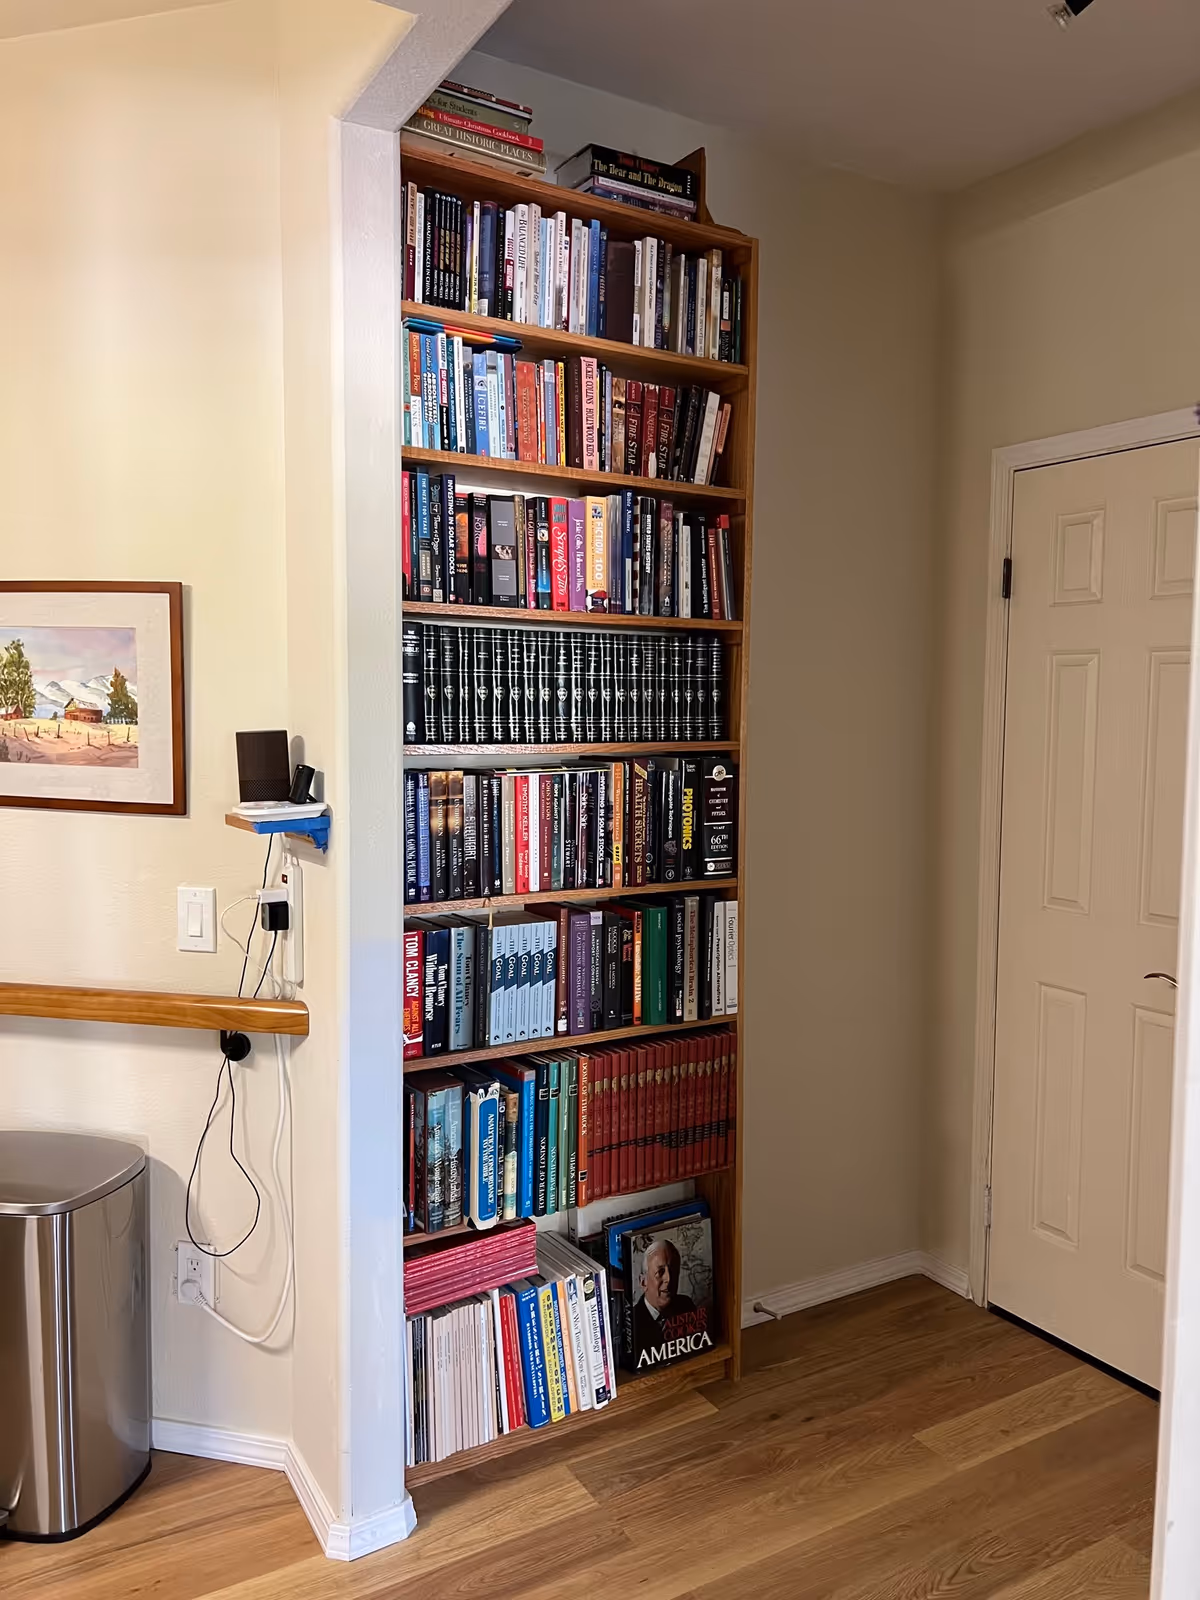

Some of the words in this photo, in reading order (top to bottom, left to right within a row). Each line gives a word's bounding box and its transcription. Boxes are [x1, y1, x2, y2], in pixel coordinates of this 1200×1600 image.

[424, 120, 452, 136] GREAT
[456, 130, 498, 150] HISTORIC
[500, 144, 533, 161] PLACES
[464, 120, 491, 134] Christmas
[492, 128, 520, 142] Cookbook
[593, 159, 608, 172] The
[609, 164, 626, 178] Bear
[628, 170, 642, 182] and
[644, 172, 656, 186] The
[658, 177, 682, 193] Dragon
[518, 219, 527, 256] BALANCED
[518, 256, 526, 271] LIFE
[584, 360, 594, 379] JACKIE
[586, 381, 594, 405] COLLINS
[478, 393, 486, 431] ICEFIRE
[586, 408, 594, 442] HOLLYWOOD
[628, 418, 637, 438] FIRE
[645, 410, 656, 448] INKHEART
[660, 423, 670, 443] FIRE
[628, 440, 637, 464] STAR
[659, 445, 668, 469] STAR
[558, 574, 567, 595] Two
[635, 778, 643, 817] HEALTH
[682, 788, 693, 850] PHOTONICS
[465, 816, 476, 860] STEELHEART
[635, 819, 643, 863] SECRETS
[405, 936, 418, 957] TOM
[406, 960, 419, 997] CLANCY
[425, 953, 437, 984] Without
[438, 964, 447, 980] Tom
[456, 977, 464, 986] of
[425, 987, 436, 1021] Remorse
[435, 981, 446, 1006] Clancy
[582, 1087, 588, 1097] OF
[433, 1159, 442, 1206] Wonderlands
[449, 1156, 459, 1202] Historylands
[539, 1171, 545, 1180] OF
[590, 1304, 602, 1353] Microbiology
[665, 1307, 707, 1328] ALISTAIR
[542, 1298, 551, 1339] HANDBOOK
[547, 1359, 557, 1413] ENCYCLOPEDIA
[574, 1331, 583, 1353] THINGS
[637, 1330, 713, 1368] AMERICA
